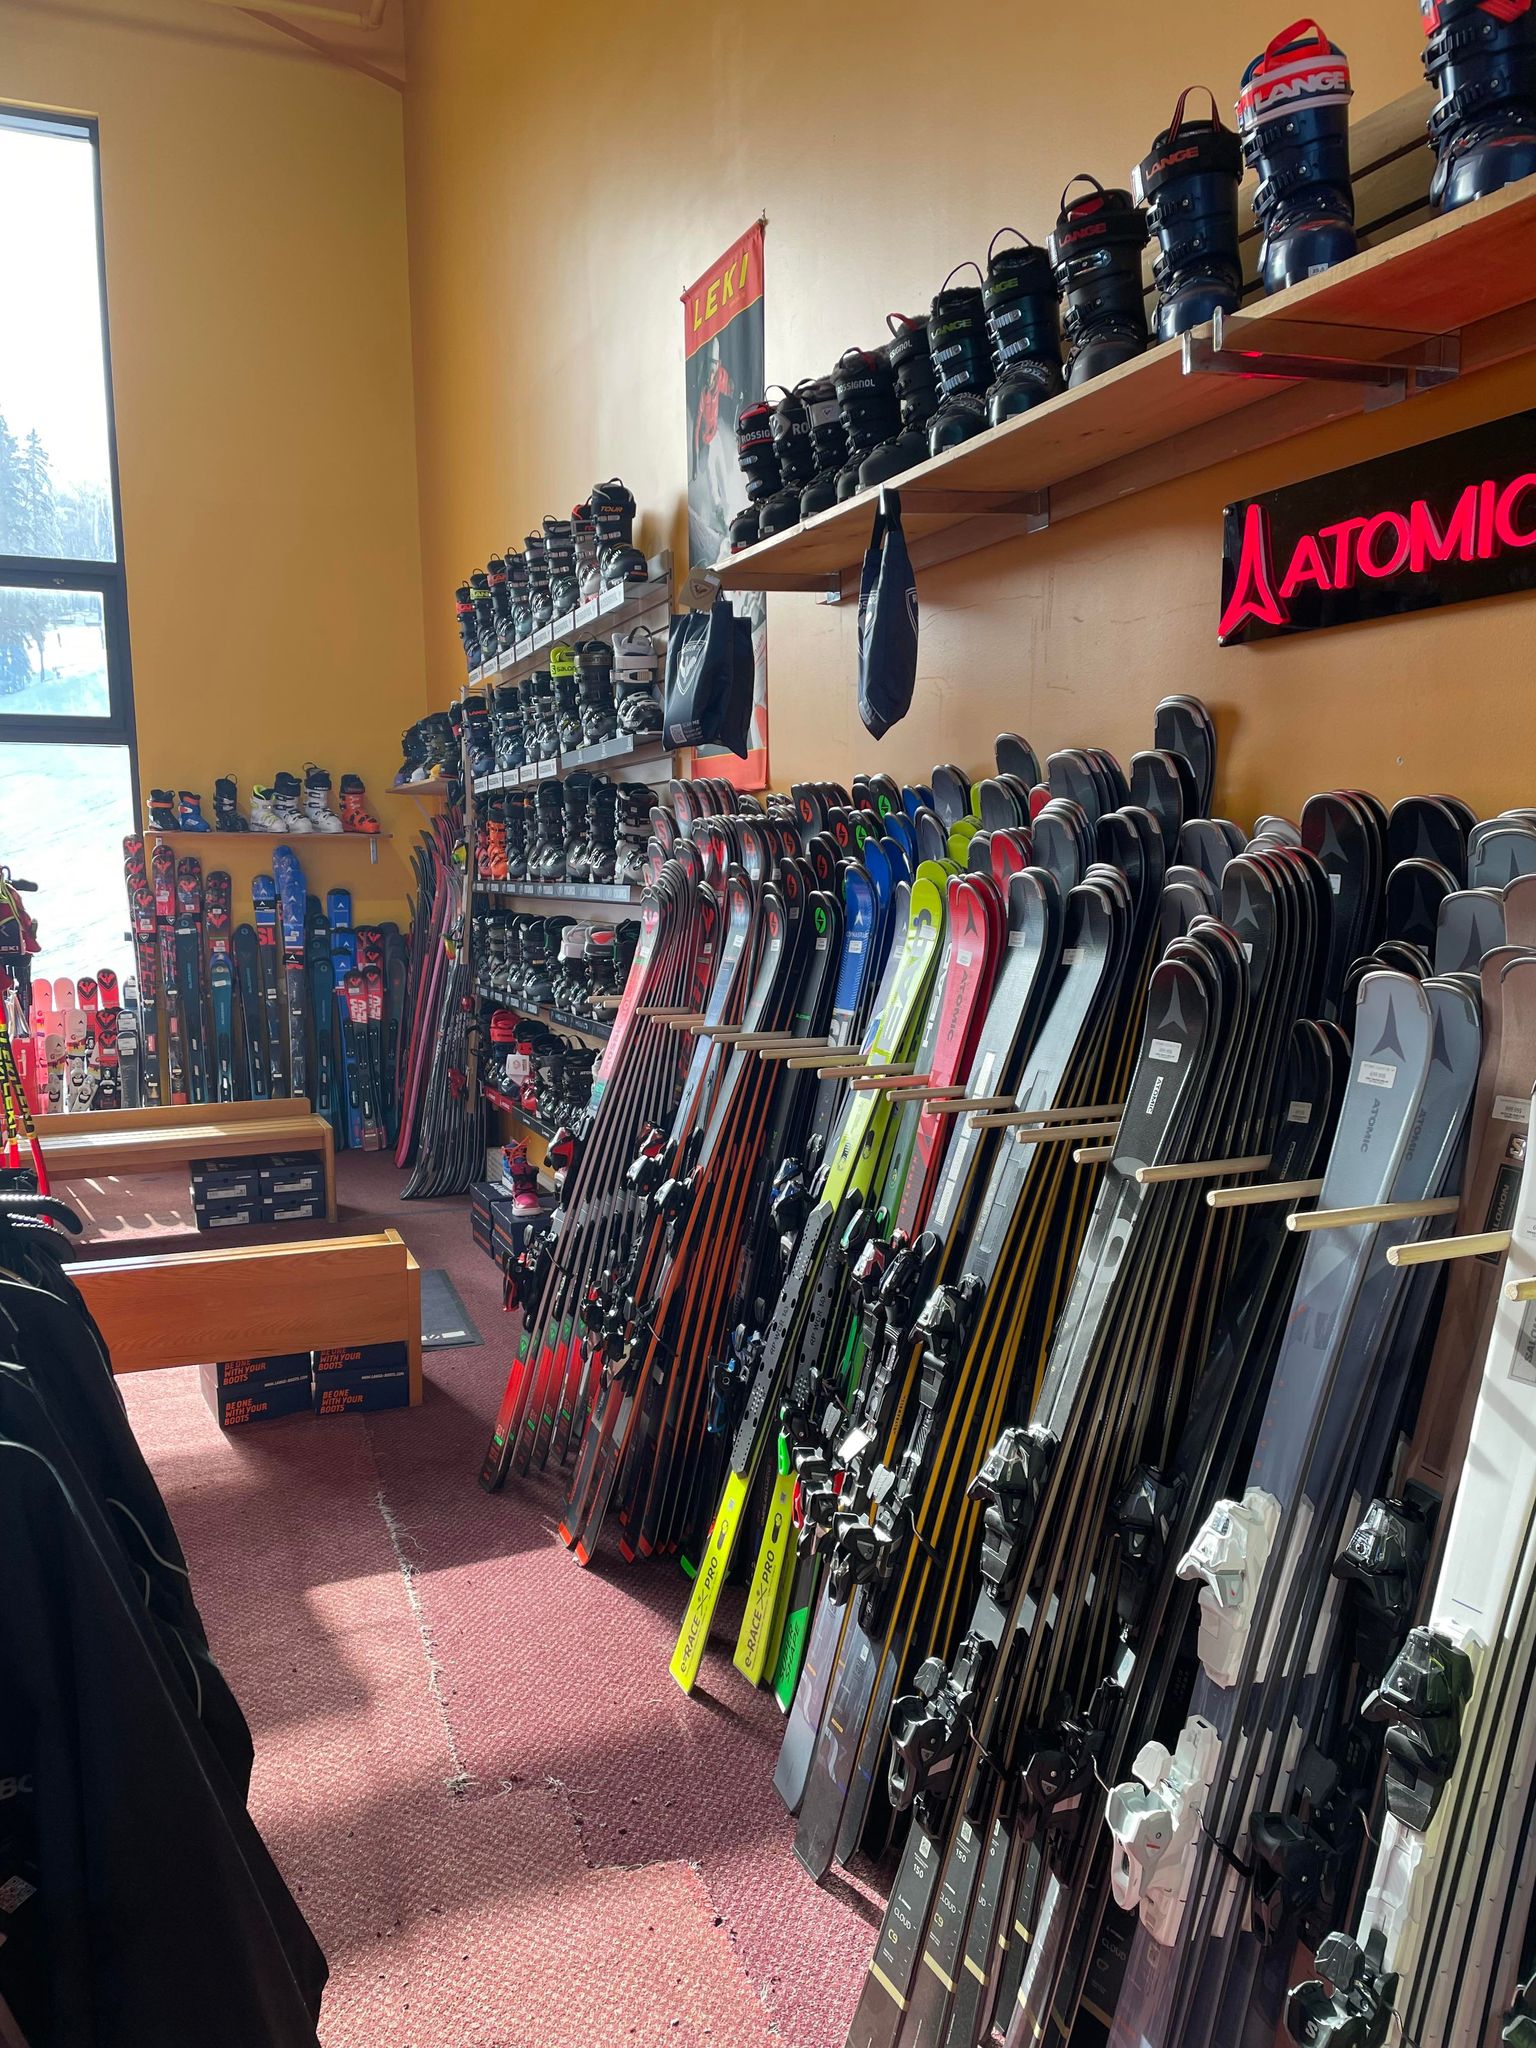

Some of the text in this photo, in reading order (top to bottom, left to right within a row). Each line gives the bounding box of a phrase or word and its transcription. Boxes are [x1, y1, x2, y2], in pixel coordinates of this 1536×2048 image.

[1253, 70, 1347, 107] LANGE
[1145, 145, 1199, 181] LANGE
[1058, 221, 1107, 248] LANGE
[693, 251, 749, 332] LEKI
[601, 505, 624, 513] TOUR
[1279, 473, 1536, 598] ATOMIC
[947, 969, 968, 1041] ATOMIC
[1147, 1078, 1163, 1113] ATOMIC
[1361, 1098, 1380, 1153] ATOMIC
[1405, 1108, 1428, 1161] ATOMIC
[1491, 1184, 1510, 1233] ALOMON
[318, 1361, 343, 1371] BOOTS
[320, 1352, 361, 1363] WITH YOUR
[224, 1362, 267, 1377] WITH YOUR
[223, 1375, 248, 1386] BOOTS
[322, 1394, 363, 1406] WITH YOUR
[323, 1388, 350, 1399] BE ONE
[226, 1398, 252, 1411] BE ONE
[226, 1402, 268, 1418] WITH YOUR
[320, 1405, 345, 1414] BOOTS
[224, 1416, 249, 1426] BOOTS
[680, 1556, 718, 1673] e-RACE PRO
[744, 1550, 775, 1668] e-RACE PRO
[955, 1847, 967, 1864] 150
[913, 1862, 924, 1879] 150
[893, 1906, 912, 1931] CLOUD
[934, 1912, 944, 1928] C9
[888, 1928, 898, 1945] C9
